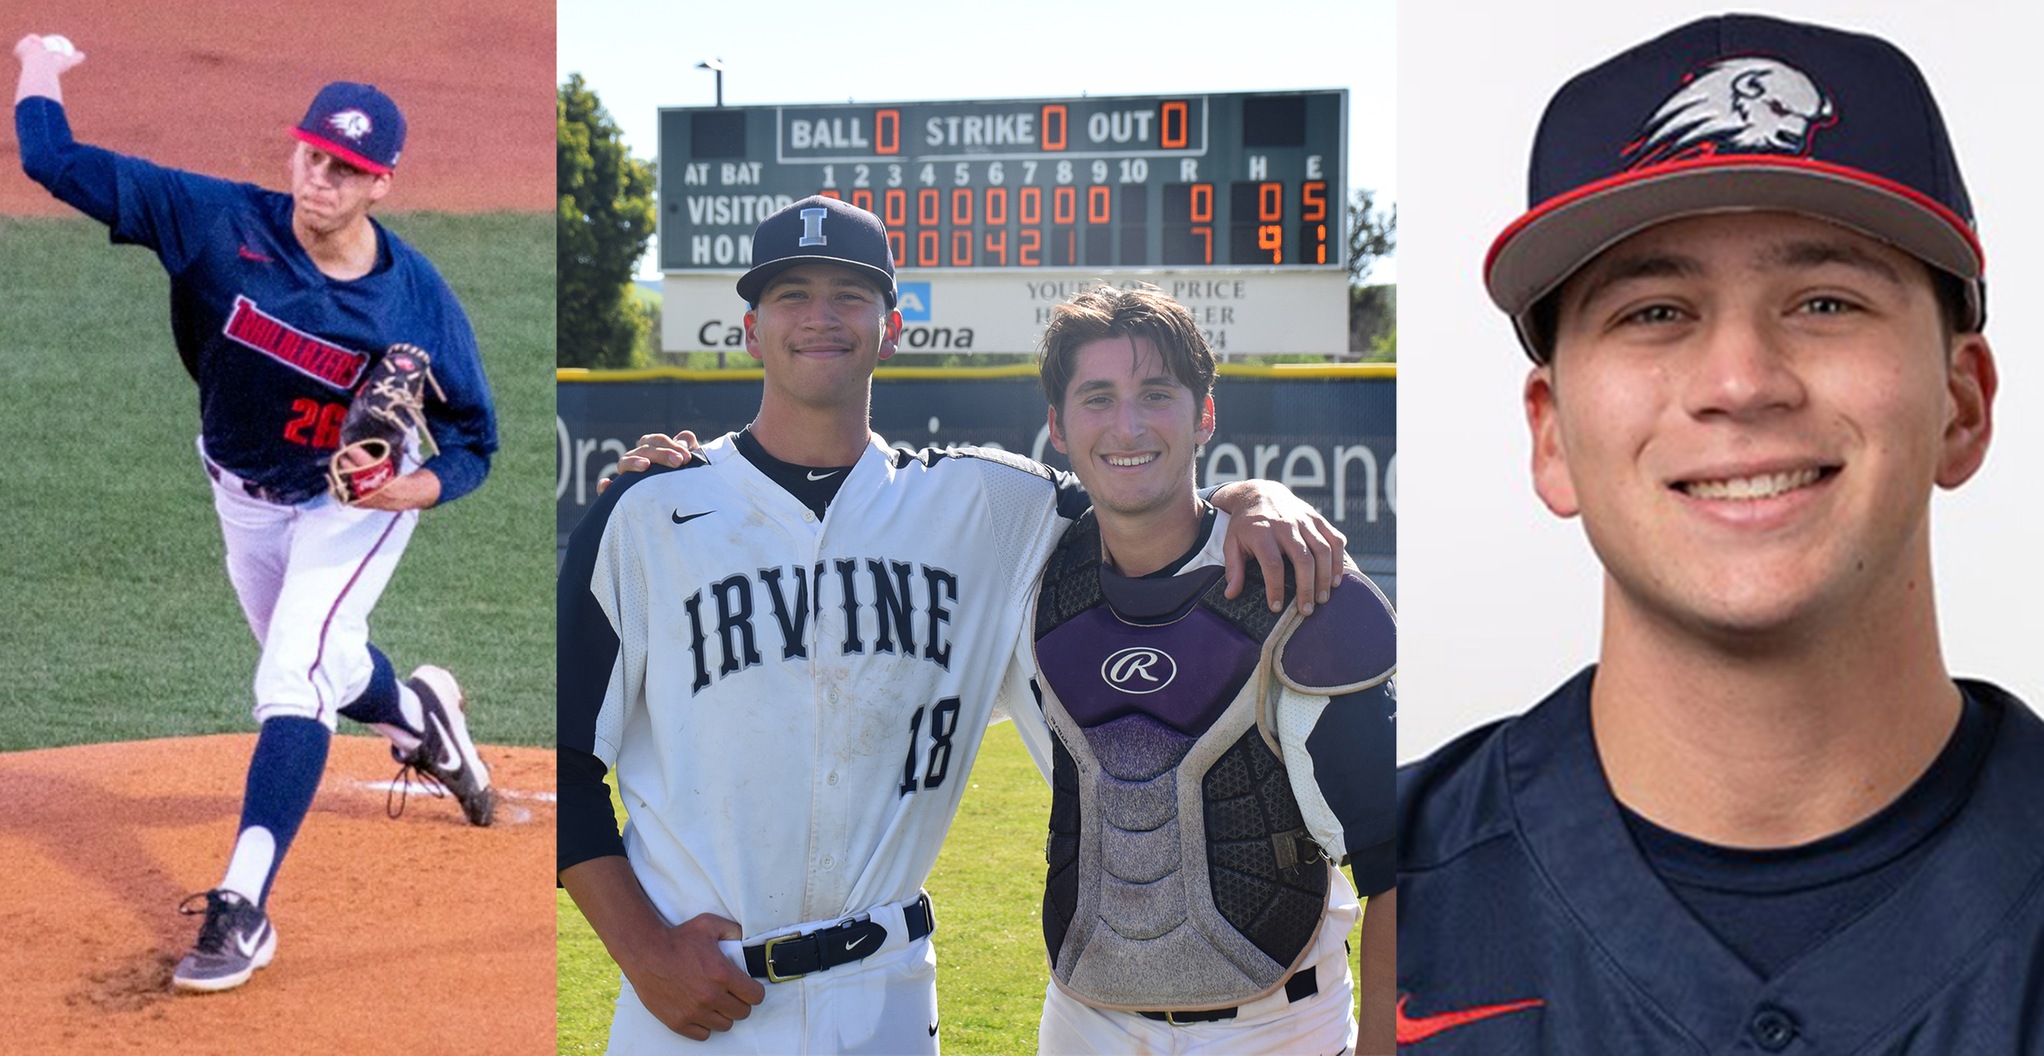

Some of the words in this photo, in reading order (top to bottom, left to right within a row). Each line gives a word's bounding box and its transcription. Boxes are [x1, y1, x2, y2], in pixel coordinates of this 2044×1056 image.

[791, 118, 868, 149] BALL
[875, 109, 900, 155] 0
[926, 112, 1034, 147] STRIKE
[1042, 104, 1067, 151] 0
[1088, 109, 1154, 143] OUT
[1161, 101, 1188, 149] 0
[685, 163, 709, 186] AT
[721, 162, 763, 186] BAT
[823, 165, 836, 188] 1
[854, 165, 870, 188] 2
[887, 164, 902, 187] 3
[919, 163, 936, 187] 4
[954, 162, 970, 186] 5
[988, 161, 1004, 185] 6
[1022, 161, 1038, 184] 7
[1057, 160, 1073, 184] 8
[1092, 159, 1108, 183] 9
[1119, 158, 1148, 183] 10
[1180, 158, 1198, 182] R
[1250, 156, 1267, 181] H
[1307, 155, 1322, 179] E
[885, 189, 906, 227] 0
[918, 189, 940, 226] 0
[952, 188, 973, 226] 0
[985, 187, 1007, 226] 0
[1020, 187, 1042, 225] 0
[1054, 186, 1076, 225] 0
[1088, 186, 1111, 224] 0
[1190, 184, 1214, 223] 0
[1259, 183, 1282, 222] 0
[1303, 182, 1326, 221] 5
[691, 234, 753, 265] HOM
[918, 230, 940, 266] 0
[952, 230, 973, 266] 0
[985, 229, 1007, 266] 4
[1020, 229, 1041, 266] 2
[1190, 226, 1213, 265] 7
[1258, 225, 1282, 264] 9
[1317, 225, 1326, 265] 1
[799, 207, 828, 247] I
[1173, 279, 1247, 300] PRICE
[283, 398, 348, 448] 26
[683, 556, 959, 698] IRVINE
[900, 694, 961, 801] 18
